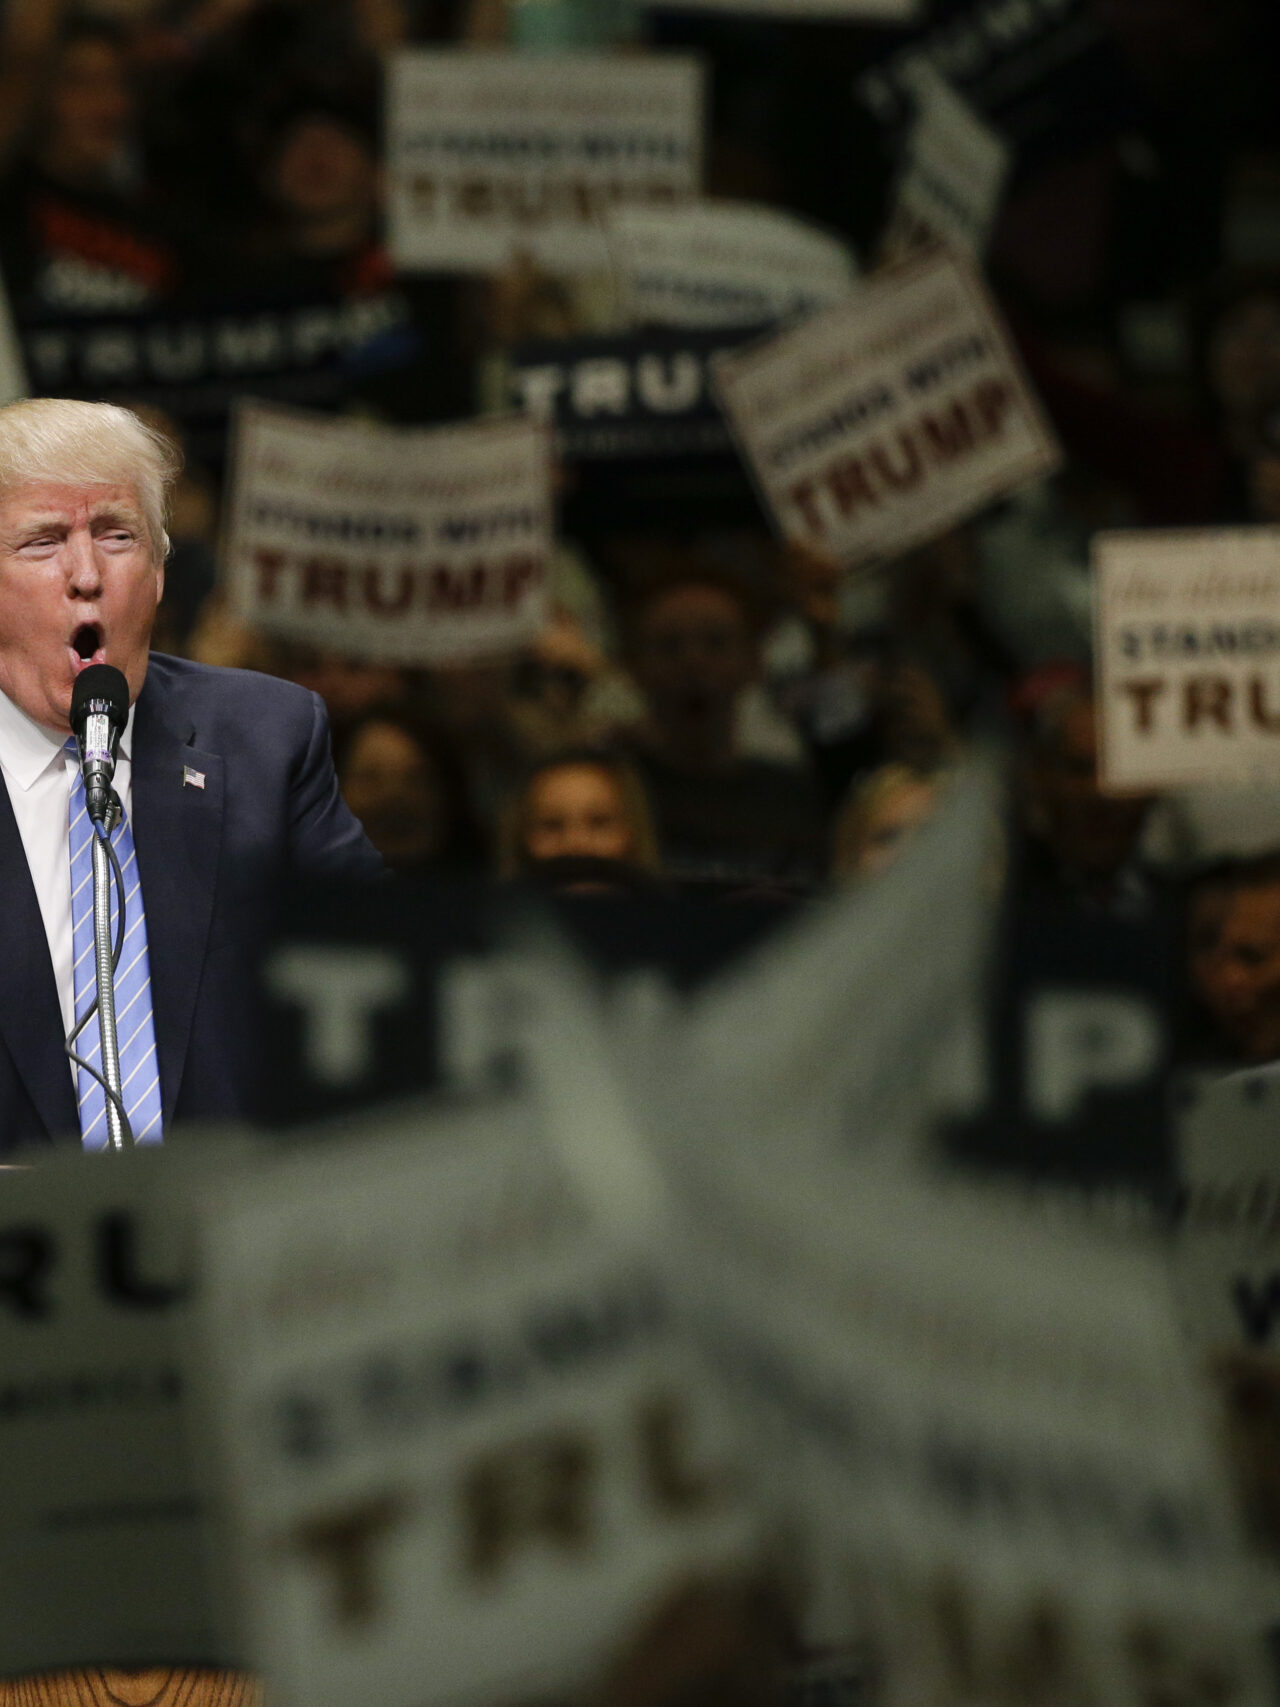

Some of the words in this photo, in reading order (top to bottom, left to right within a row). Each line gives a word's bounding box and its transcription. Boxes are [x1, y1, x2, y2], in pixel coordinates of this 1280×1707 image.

[516, 350, 724, 420] TRU
[788, 378, 1010, 540] TRUMP
[253, 550, 546, 620] TRUMP
